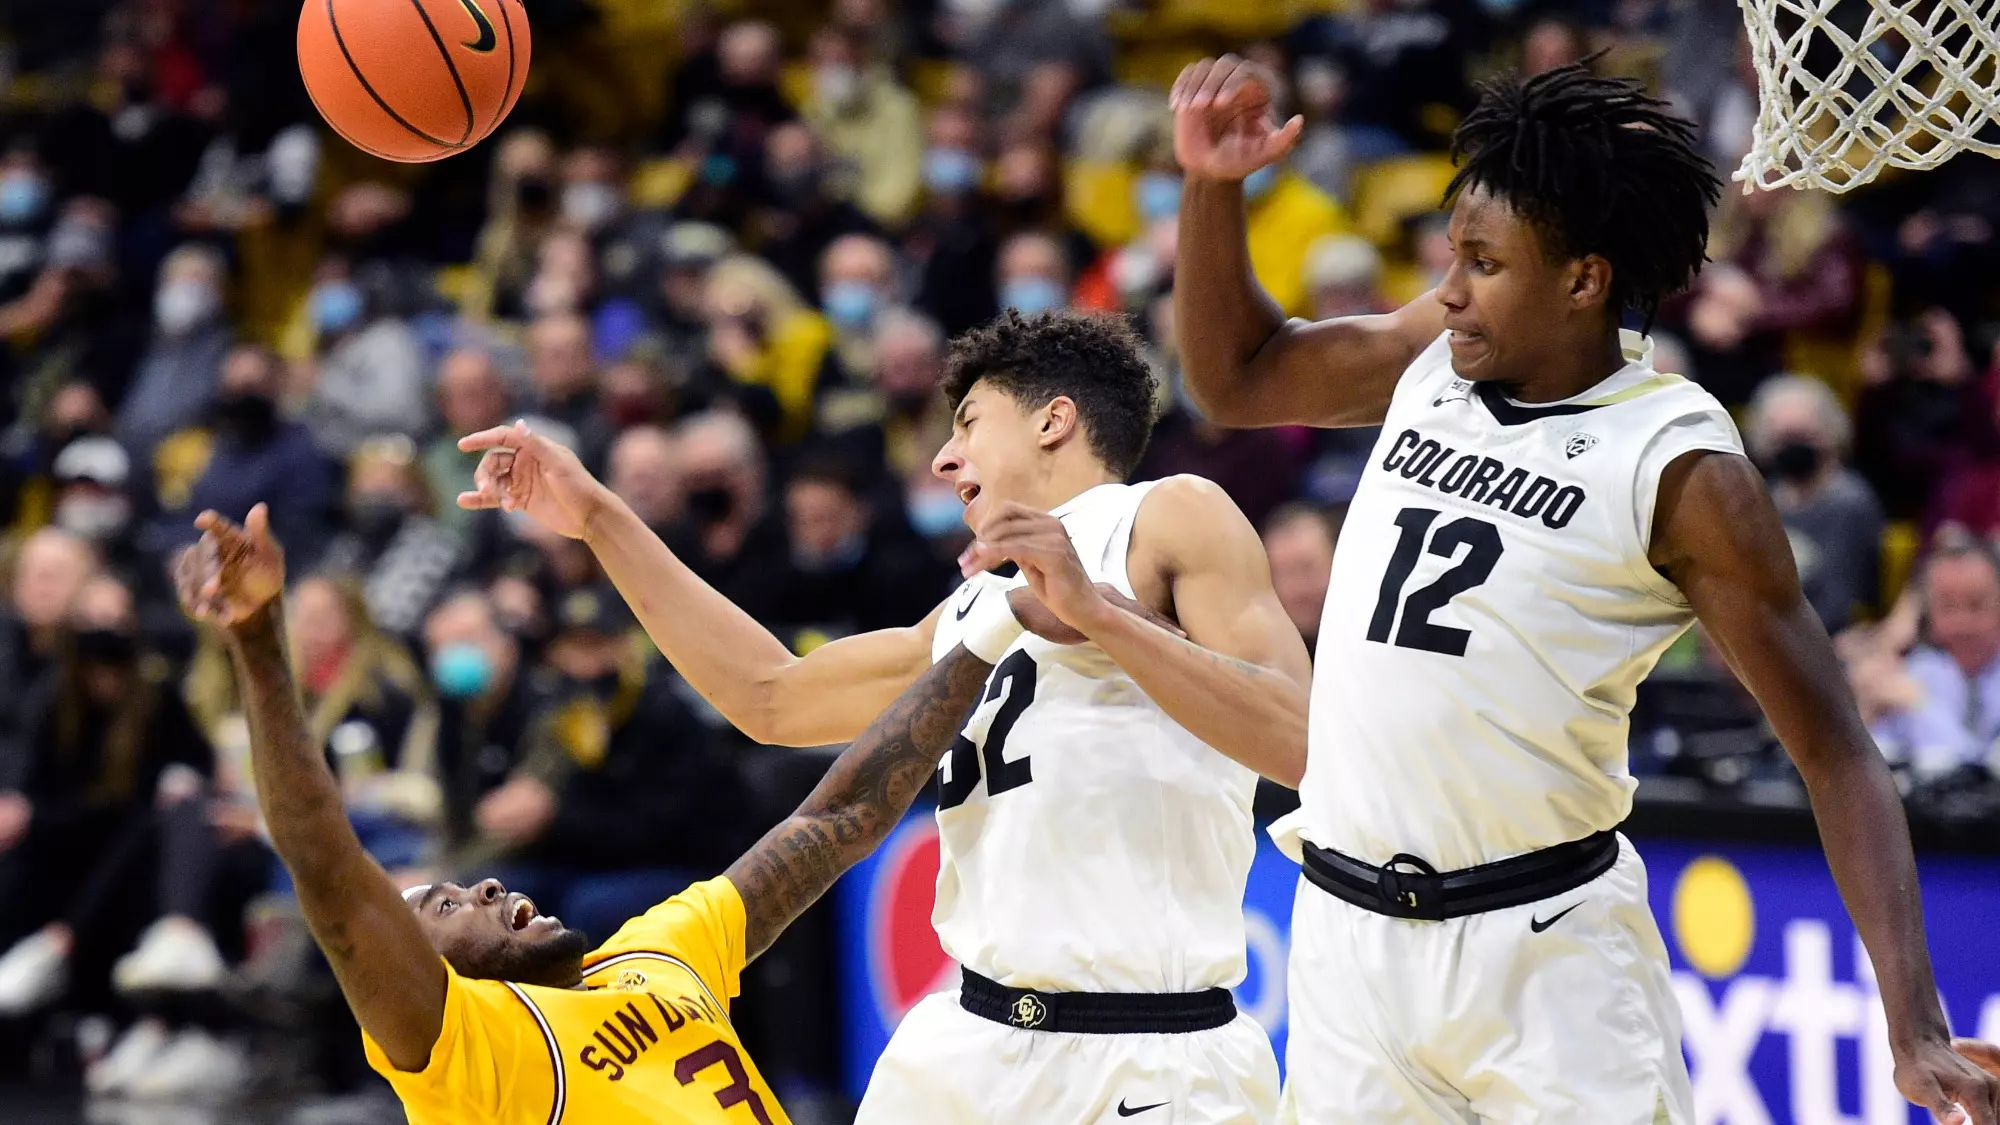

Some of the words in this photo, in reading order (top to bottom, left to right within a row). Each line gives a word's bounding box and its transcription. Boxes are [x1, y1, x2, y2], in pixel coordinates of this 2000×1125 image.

[1382, 428, 1586, 530] COLORADO
[1366, 507, 1504, 657] 12
[579, 1001, 659, 1081] SUN
[673, 1039, 774, 1125] 3
